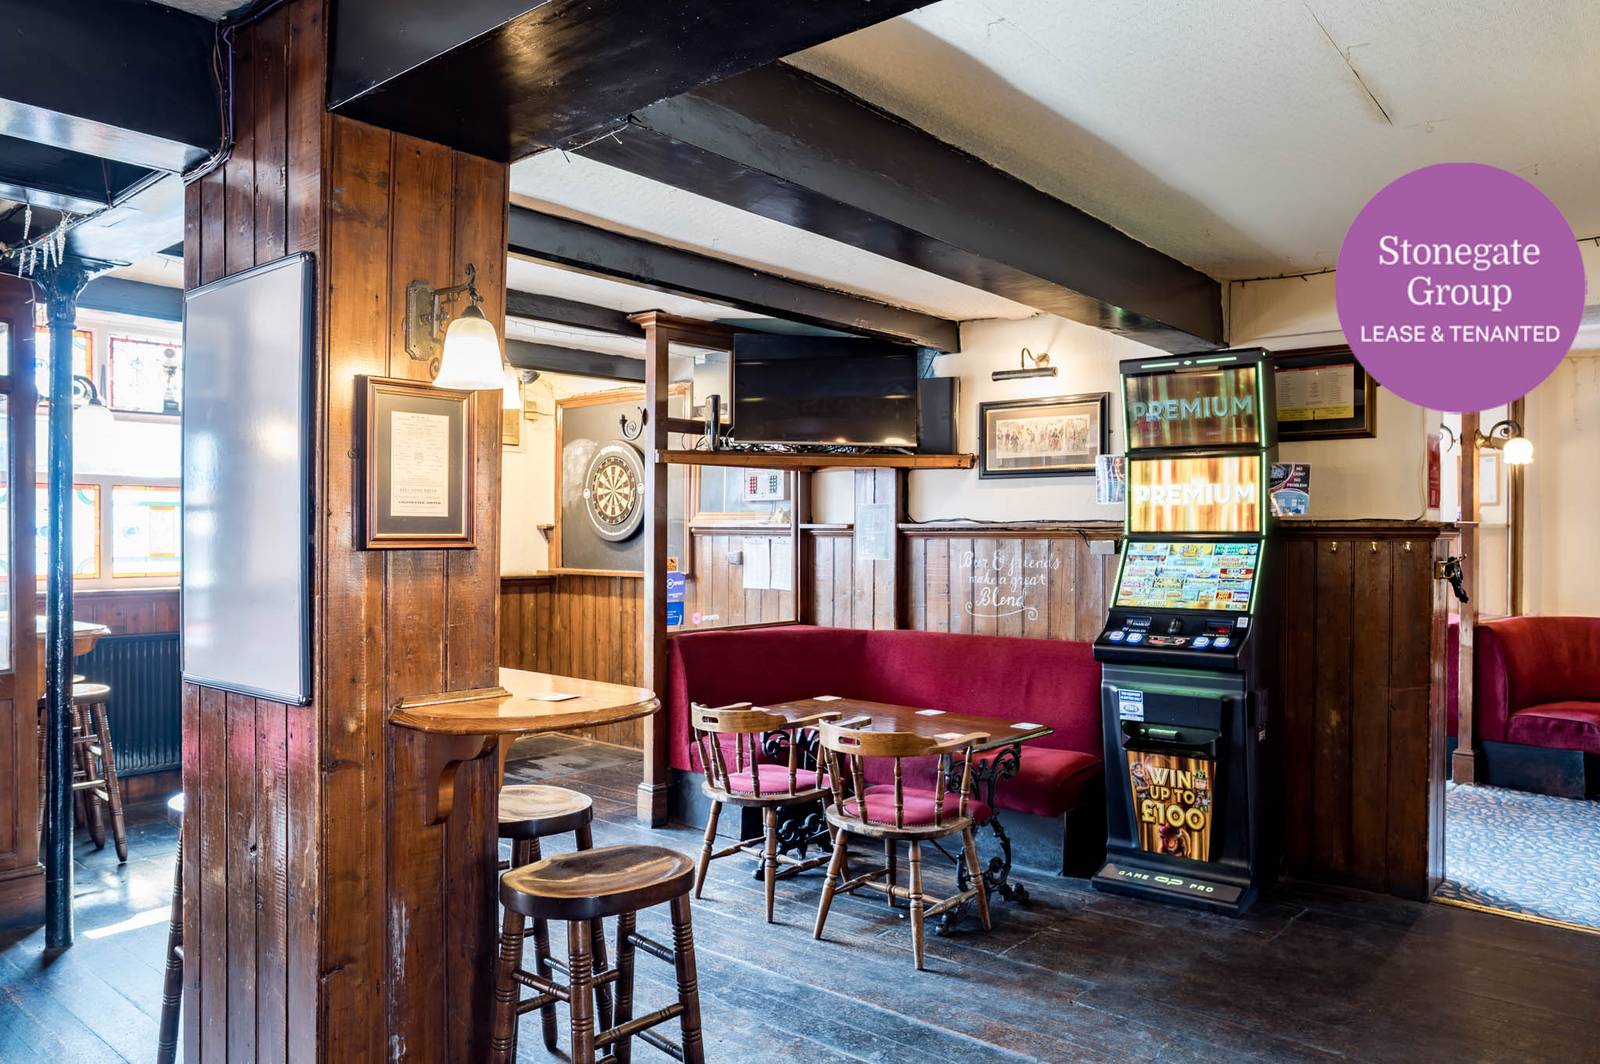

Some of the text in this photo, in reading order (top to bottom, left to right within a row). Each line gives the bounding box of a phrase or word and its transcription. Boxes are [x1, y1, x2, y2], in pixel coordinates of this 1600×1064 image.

[1131, 395, 1253, 422] PREMIUM
[1134, 483, 1256, 506] PREMIUM
[968, 570, 1046, 592] make a great
[976, 587, 1027, 608] Blend
[1149, 767, 1192, 789] WIN
[1149, 785, 1196, 805] UP TO
[1141, 799, 1206, 831] £100
[1118, 870, 1150, 881] GAME
[1189, 883, 1214, 893] PRO
